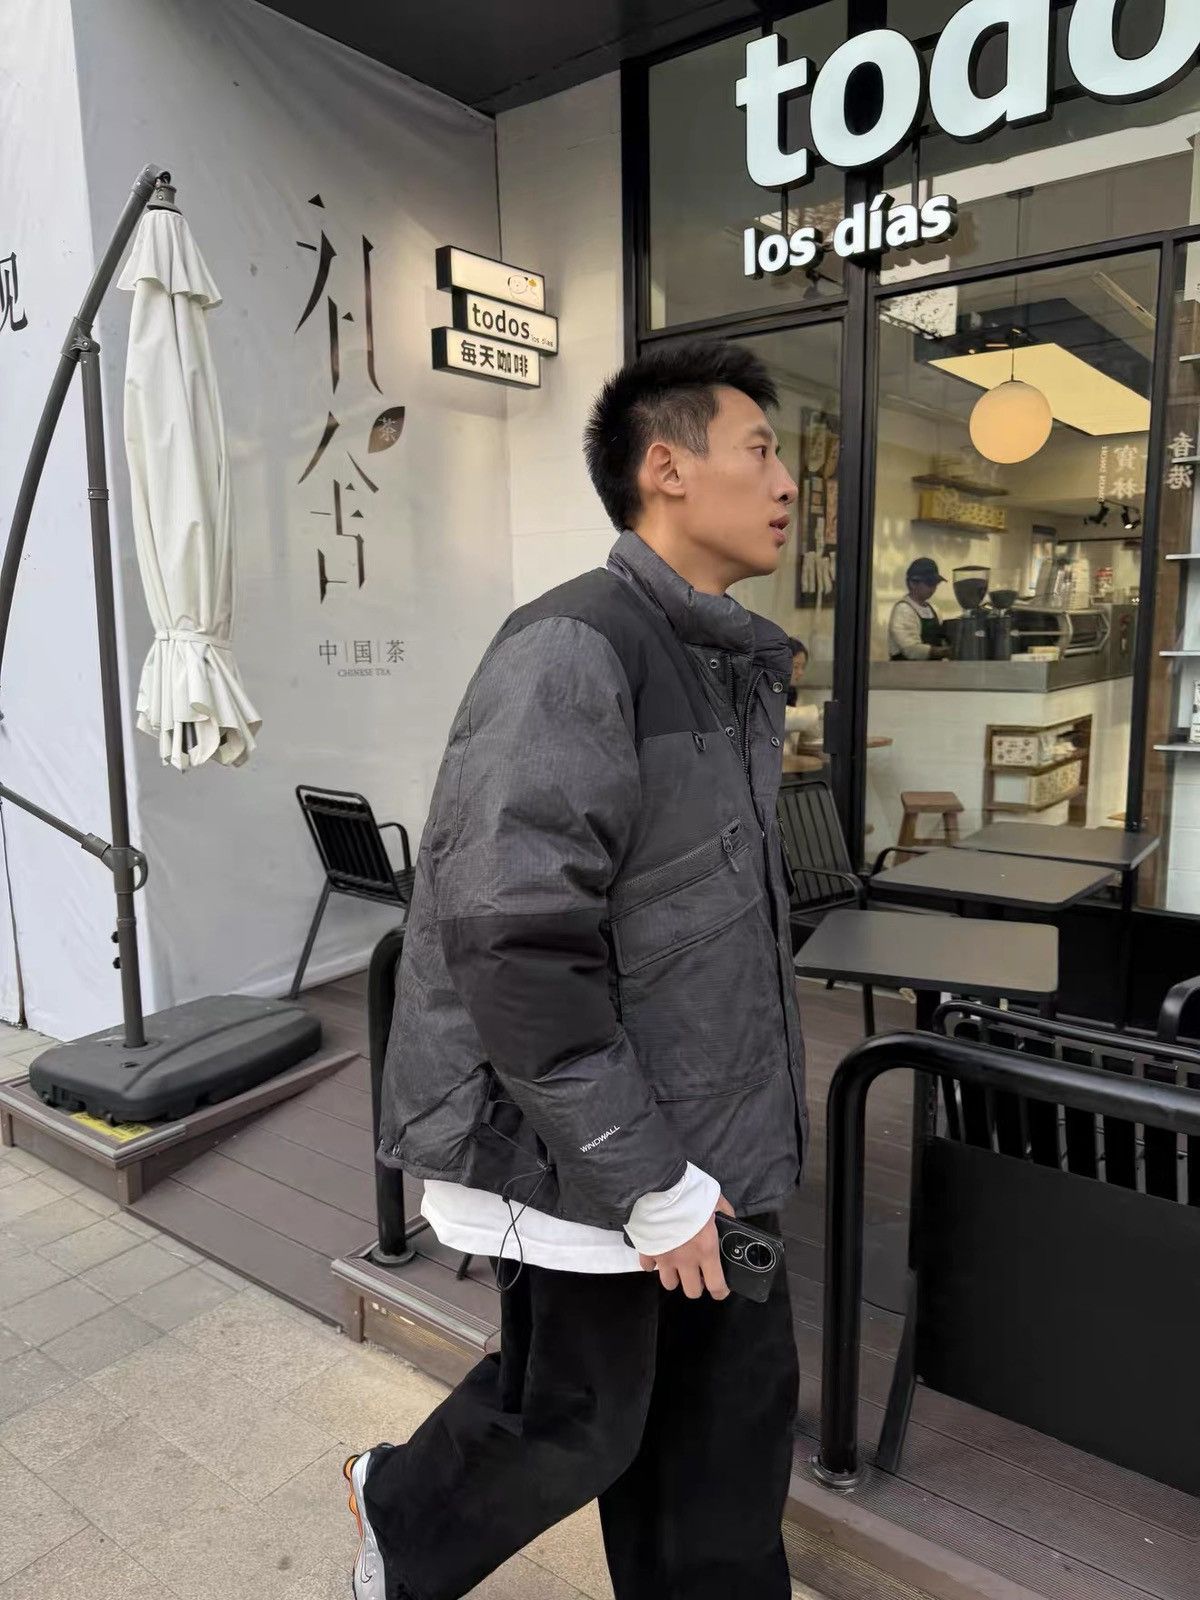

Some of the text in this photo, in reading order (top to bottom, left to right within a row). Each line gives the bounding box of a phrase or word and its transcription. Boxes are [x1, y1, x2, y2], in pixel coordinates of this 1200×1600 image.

[743, 193, 954, 277] los días
[472, 302, 530, 339] todos
[461, 340, 529, 377] 每天咖啡
[580, 1125, 621, 1153] WINDWALL
